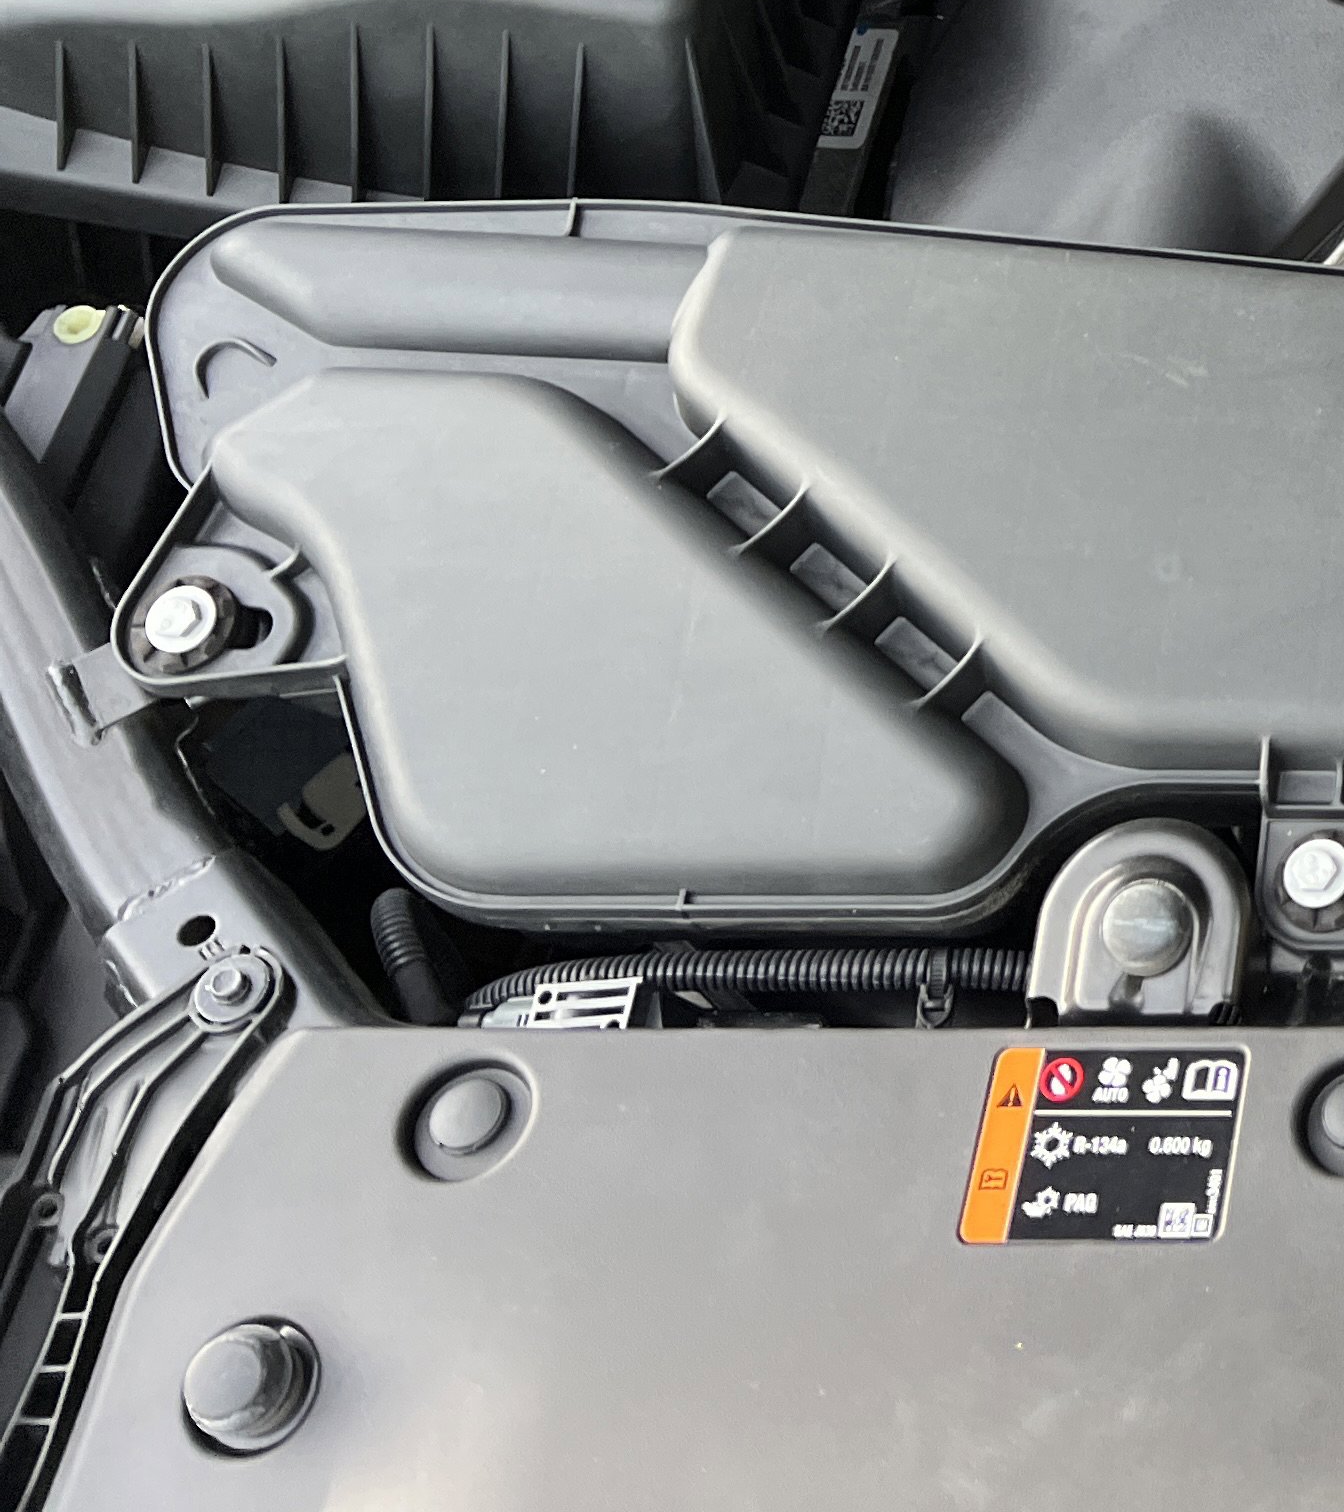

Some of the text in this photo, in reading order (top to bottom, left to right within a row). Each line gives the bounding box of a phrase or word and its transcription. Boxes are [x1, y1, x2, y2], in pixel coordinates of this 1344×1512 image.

[1092, 1087, 1129, 1104] AUTO
[1073, 1135, 1128, 1156] R-134a
[1192, 1137, 1213, 1159] kg
